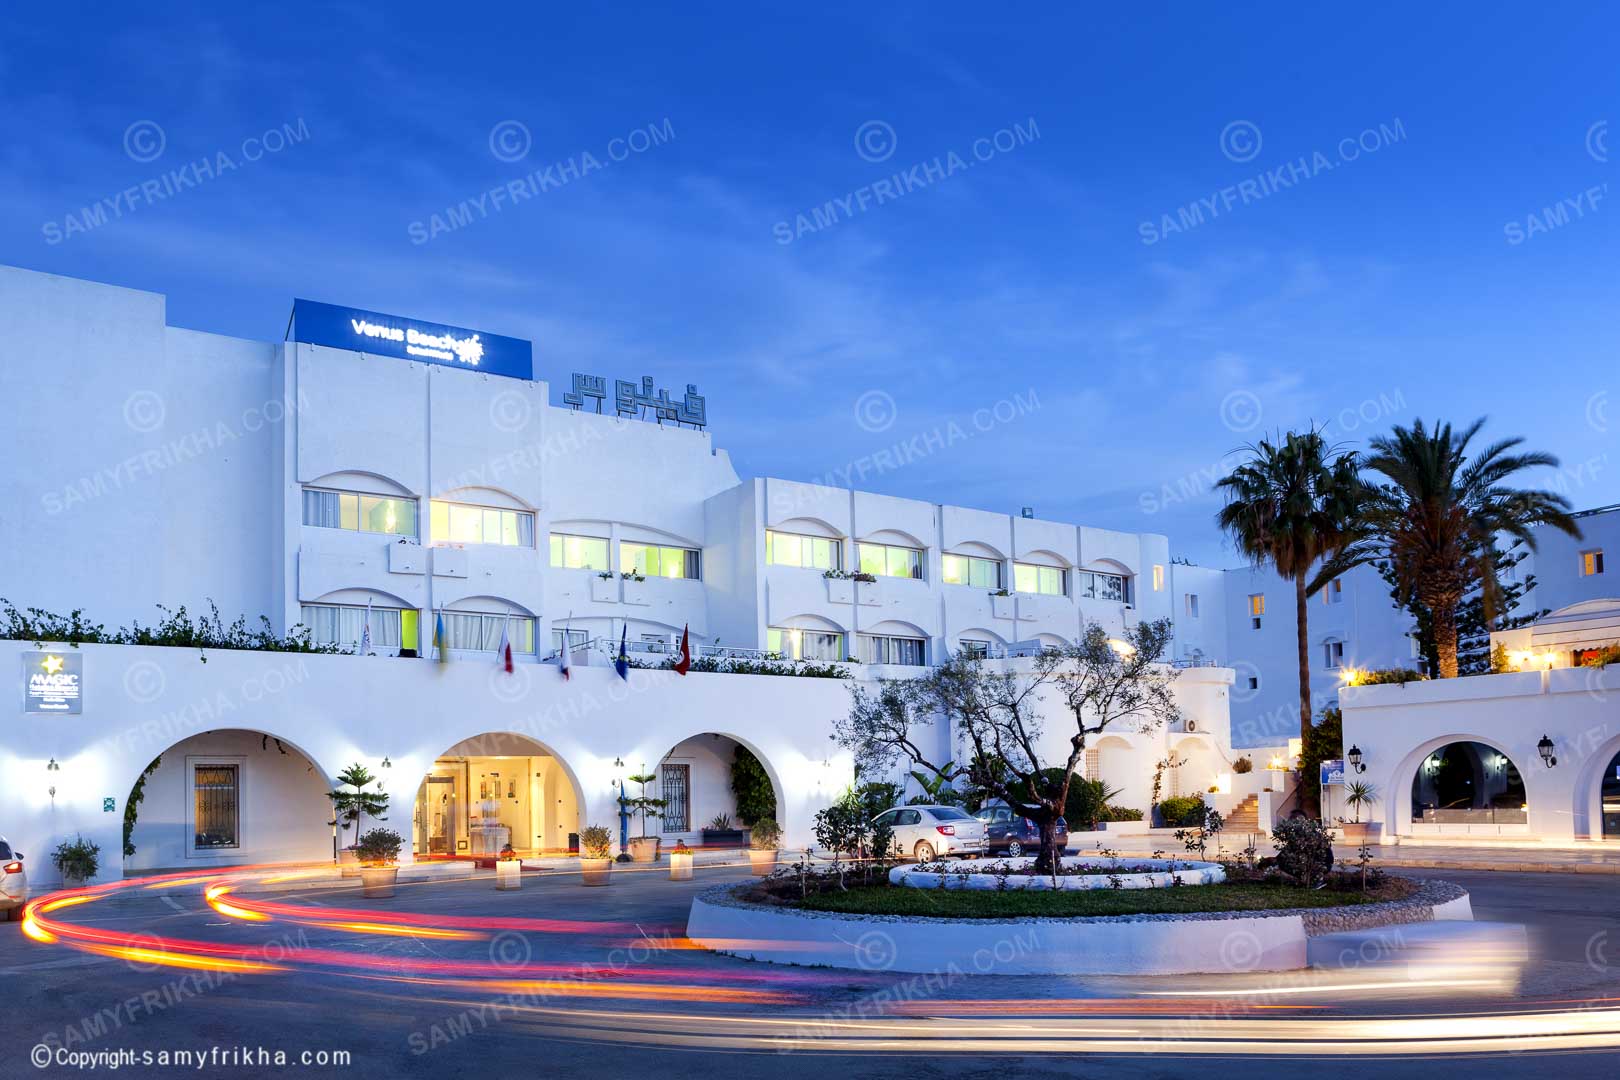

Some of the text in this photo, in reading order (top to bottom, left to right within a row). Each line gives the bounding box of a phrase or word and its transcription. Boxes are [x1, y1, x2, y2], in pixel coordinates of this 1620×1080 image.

[351, 319, 457, 350] Venus Beach
[563, 372, 707, 427] فينوس
[30, 673, 79, 686] MAGIC
